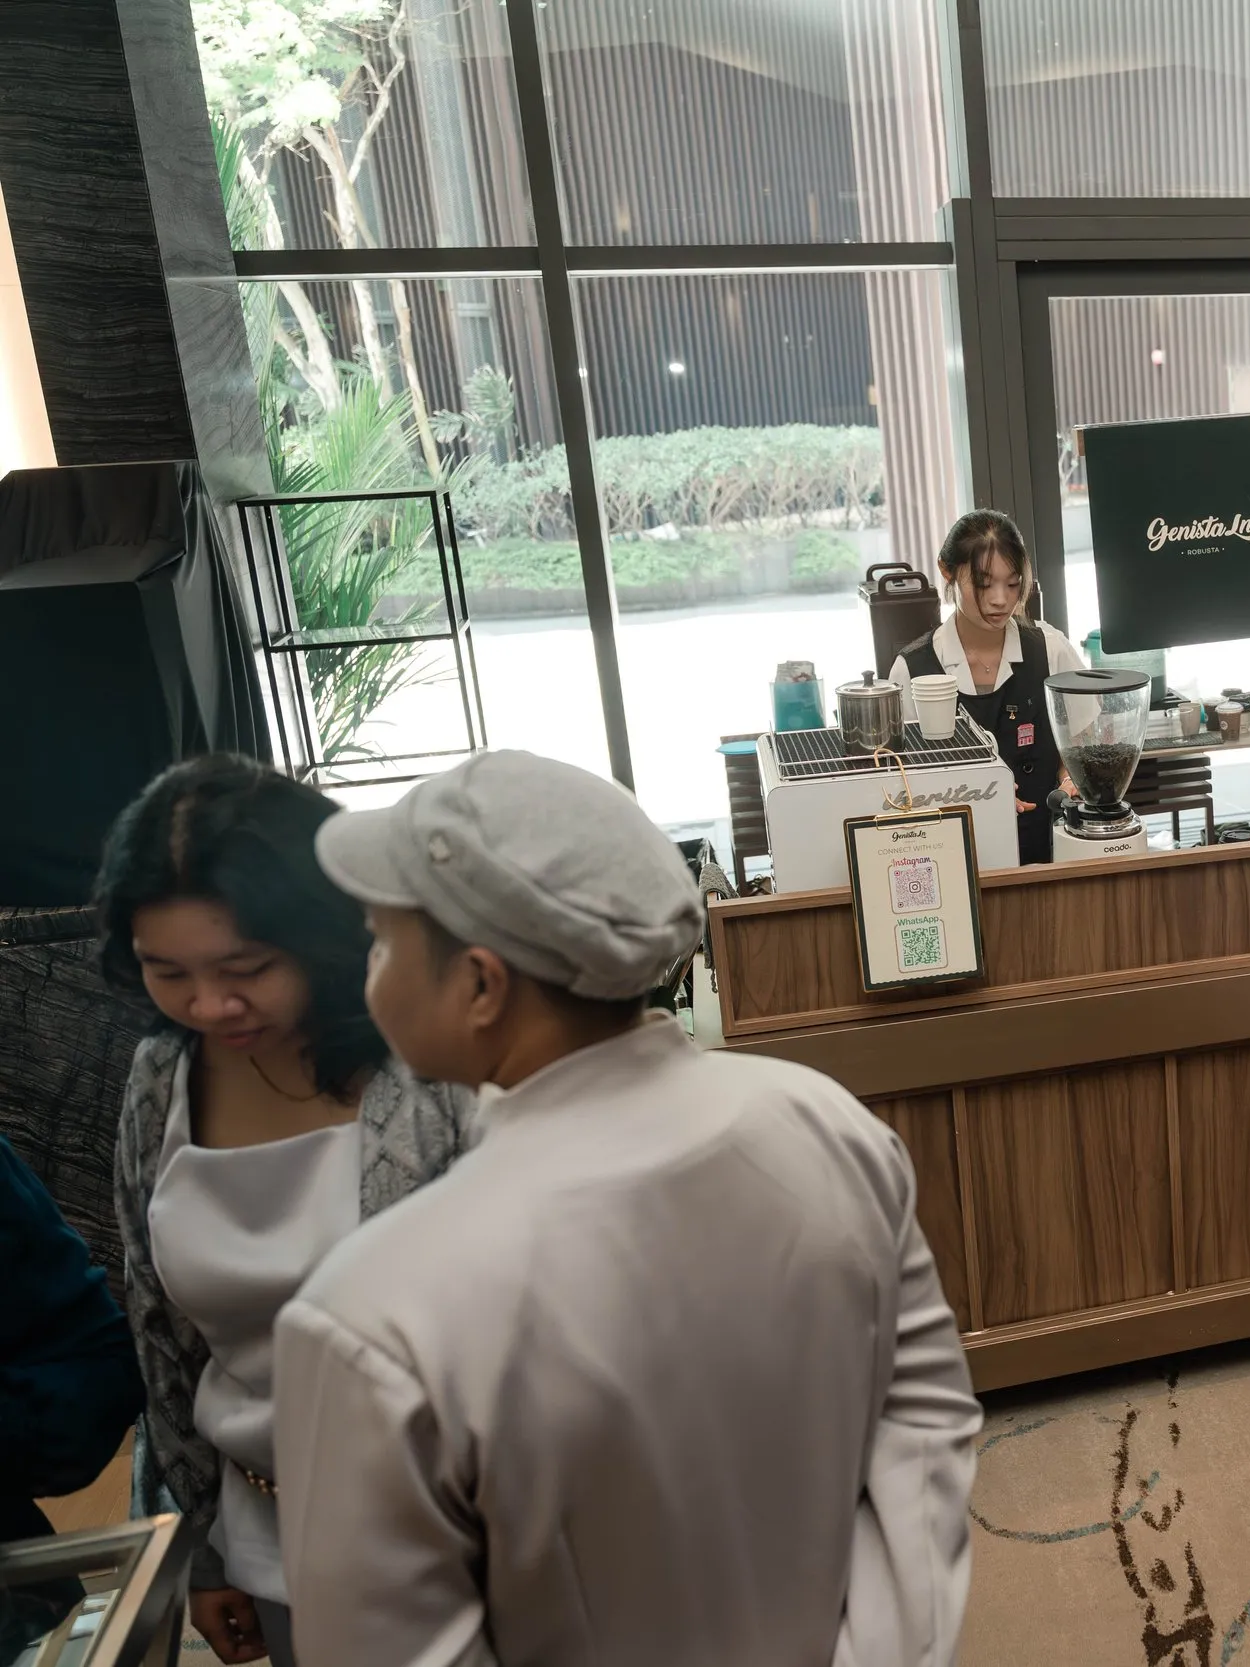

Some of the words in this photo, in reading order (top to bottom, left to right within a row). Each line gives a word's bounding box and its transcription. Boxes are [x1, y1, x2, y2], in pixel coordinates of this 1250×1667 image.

[1146, 515, 1227, 552] Genista
[1187, 546, 1220, 556] ROBUSTA
[891, 830, 918, 843] Genista
[877, 846, 912, 856] CONNECT
[912, 844, 933, 853] WITH
[891, 856, 932, 868] Instagram
[896, 915, 939, 926] WhatsApp
